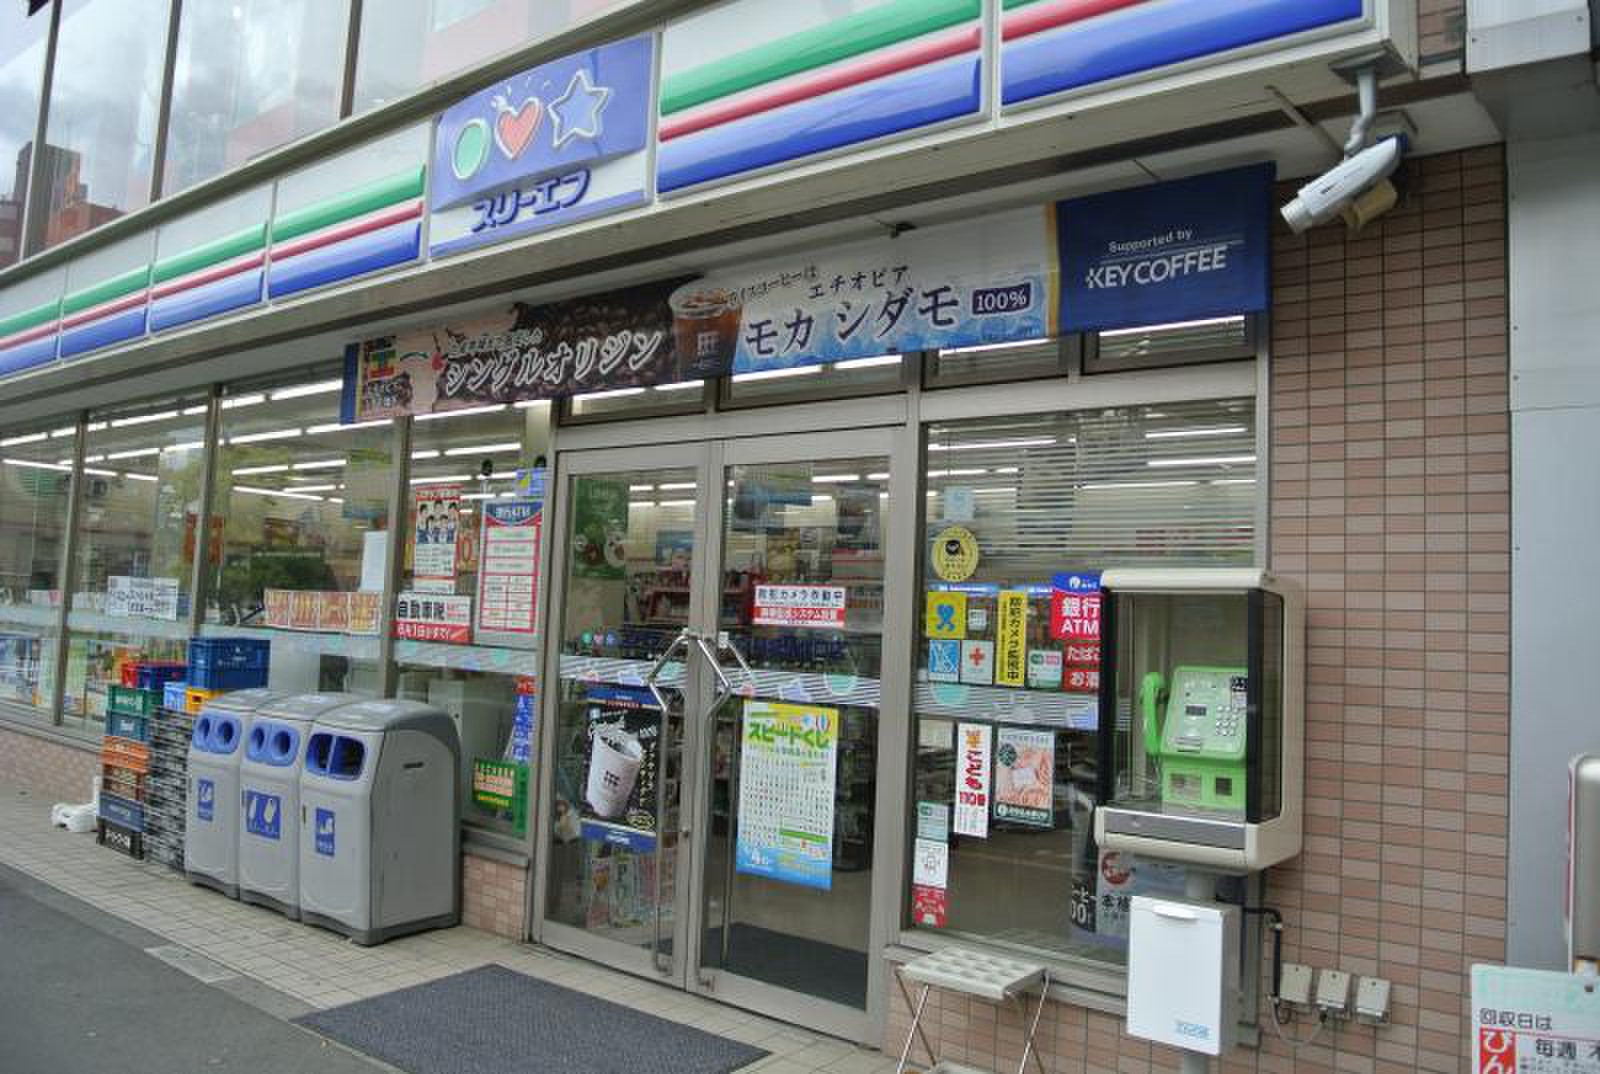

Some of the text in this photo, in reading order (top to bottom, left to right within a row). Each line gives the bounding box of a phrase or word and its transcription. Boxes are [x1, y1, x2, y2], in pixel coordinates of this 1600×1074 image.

[472, 167, 591, 233] スリーエフ
[1109, 227, 1193, 253] Supported by
[808, 265, 908, 299] エチオピア
[975, 289, 1028, 312] 100%
[745, 310, 816, 355] モカ
[1062, 596, 1101, 618] 銀行
[1060, 618, 1100, 636] ATM
[1480, 1007, 1552, 1030] 回収日は
[1535, 1038, 1577, 1060] 毎週
